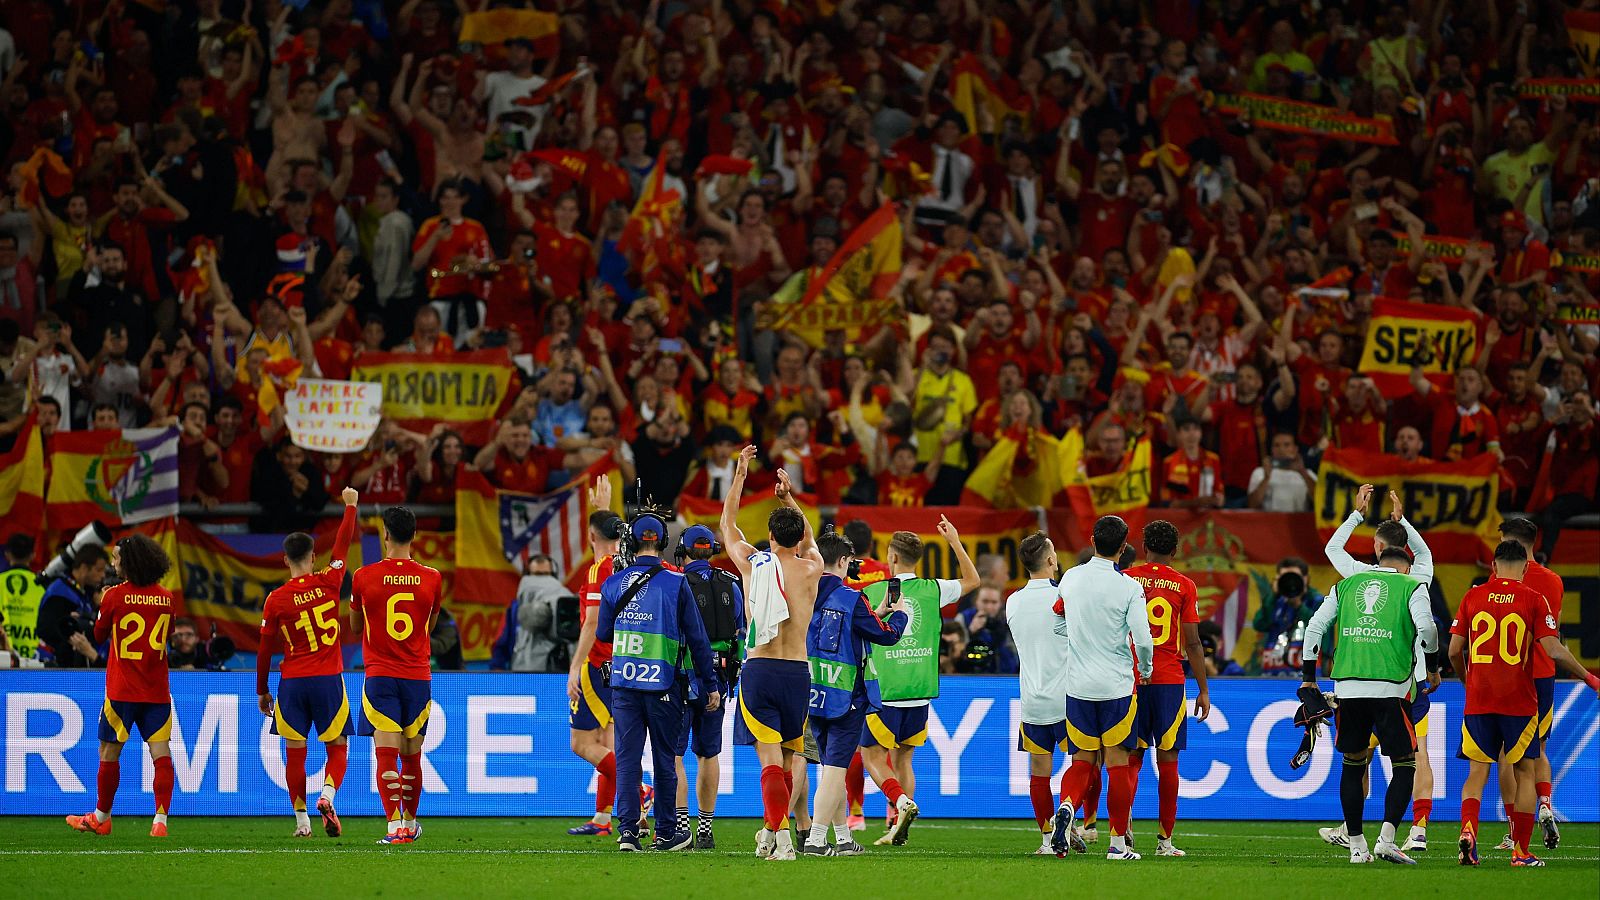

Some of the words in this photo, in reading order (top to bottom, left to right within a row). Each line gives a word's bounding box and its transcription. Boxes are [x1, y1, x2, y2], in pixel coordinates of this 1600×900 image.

[383, 575, 421, 585] MERINO
[1154, 578, 1181, 592] YAMAL
[124, 594, 171, 606] CUCURELLA
[293, 590, 316, 606] ÁLEX
[316, 587, 326, 599] B.
[1488, 592, 1515, 604] PEDRI
[386, 592, 415, 641] 6
[1146, 596, 1173, 646] 9
[1358, 617, 1377, 626] UEFA
[295, 600, 339, 652] 15
[1343, 627, 1393, 639] EURO2024
[120, 612, 171, 660] 24
[612, 633, 644, 654] HB
[1471, 611, 1527, 665] 20
[885, 648, 933, 659] EURO2024
